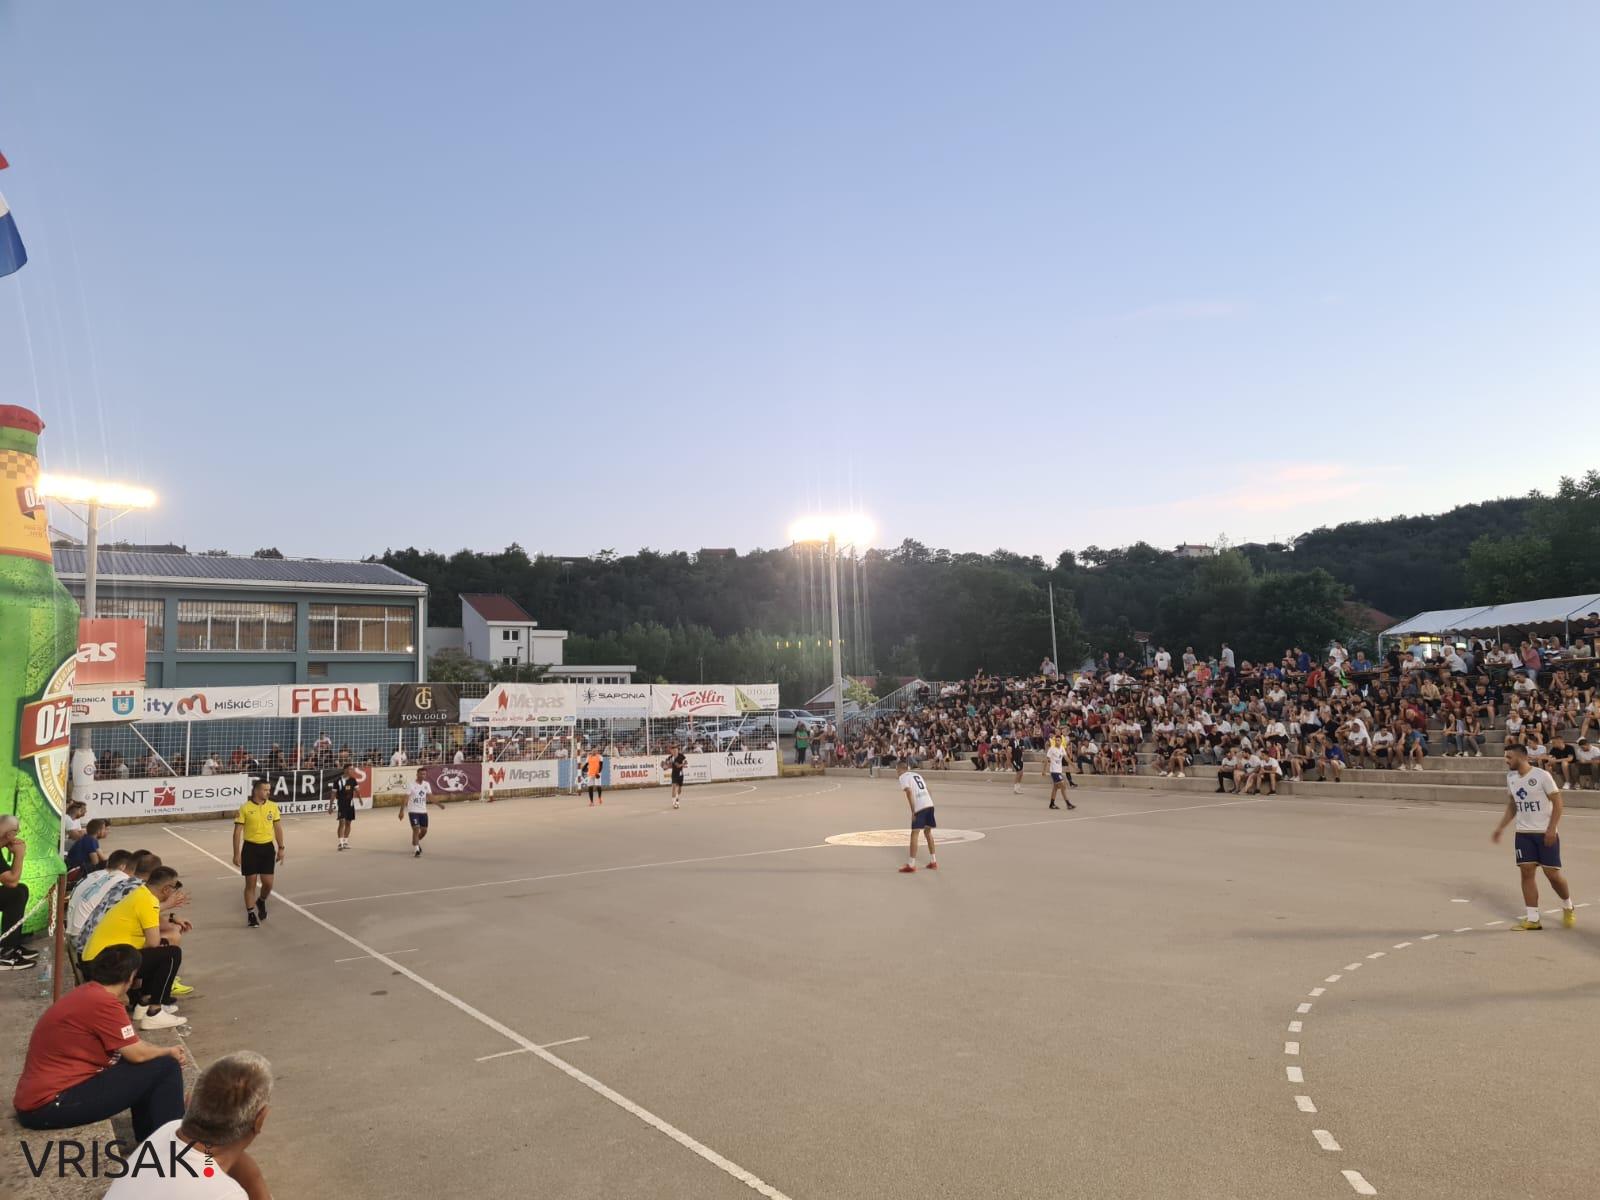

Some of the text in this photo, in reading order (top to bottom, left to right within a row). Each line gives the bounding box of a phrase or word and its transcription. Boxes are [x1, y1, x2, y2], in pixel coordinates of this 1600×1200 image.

[292, 688, 367, 713] FEAL
[509, 769, 551, 782] Mepas
[620, 769, 649, 779] DAMAC
[913, 775, 925, 790] 6
[182, 786, 243, 800] DESIGN
[1524, 801, 1541, 812] PET
